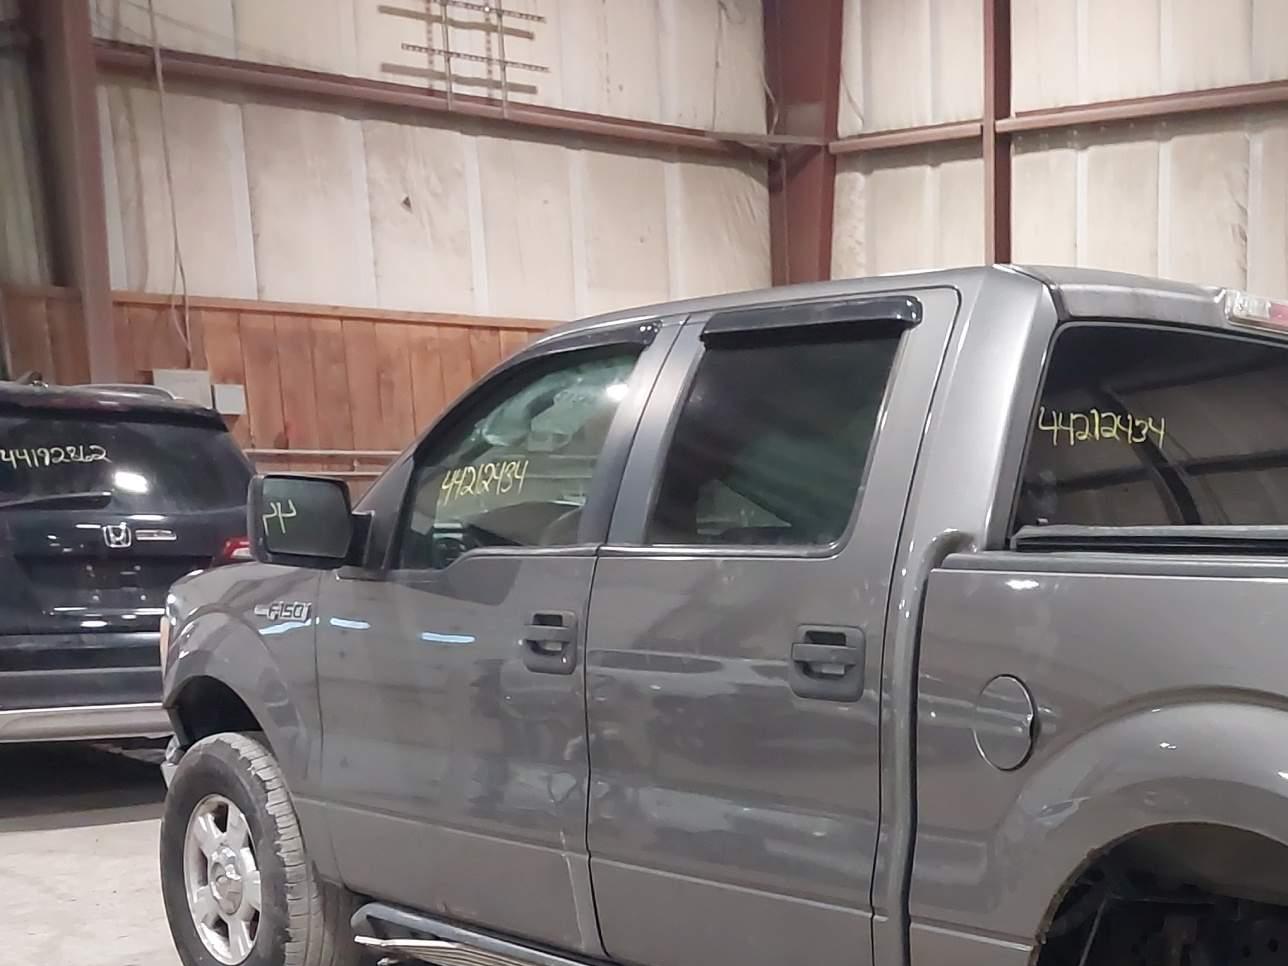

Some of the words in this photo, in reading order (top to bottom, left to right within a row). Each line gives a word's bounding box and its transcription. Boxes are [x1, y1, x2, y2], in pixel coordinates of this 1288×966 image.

[1038, 406, 1166, 450] 44212434
[440, 459, 530, 507] 44212434
[264, 600, 309, 623] F150
